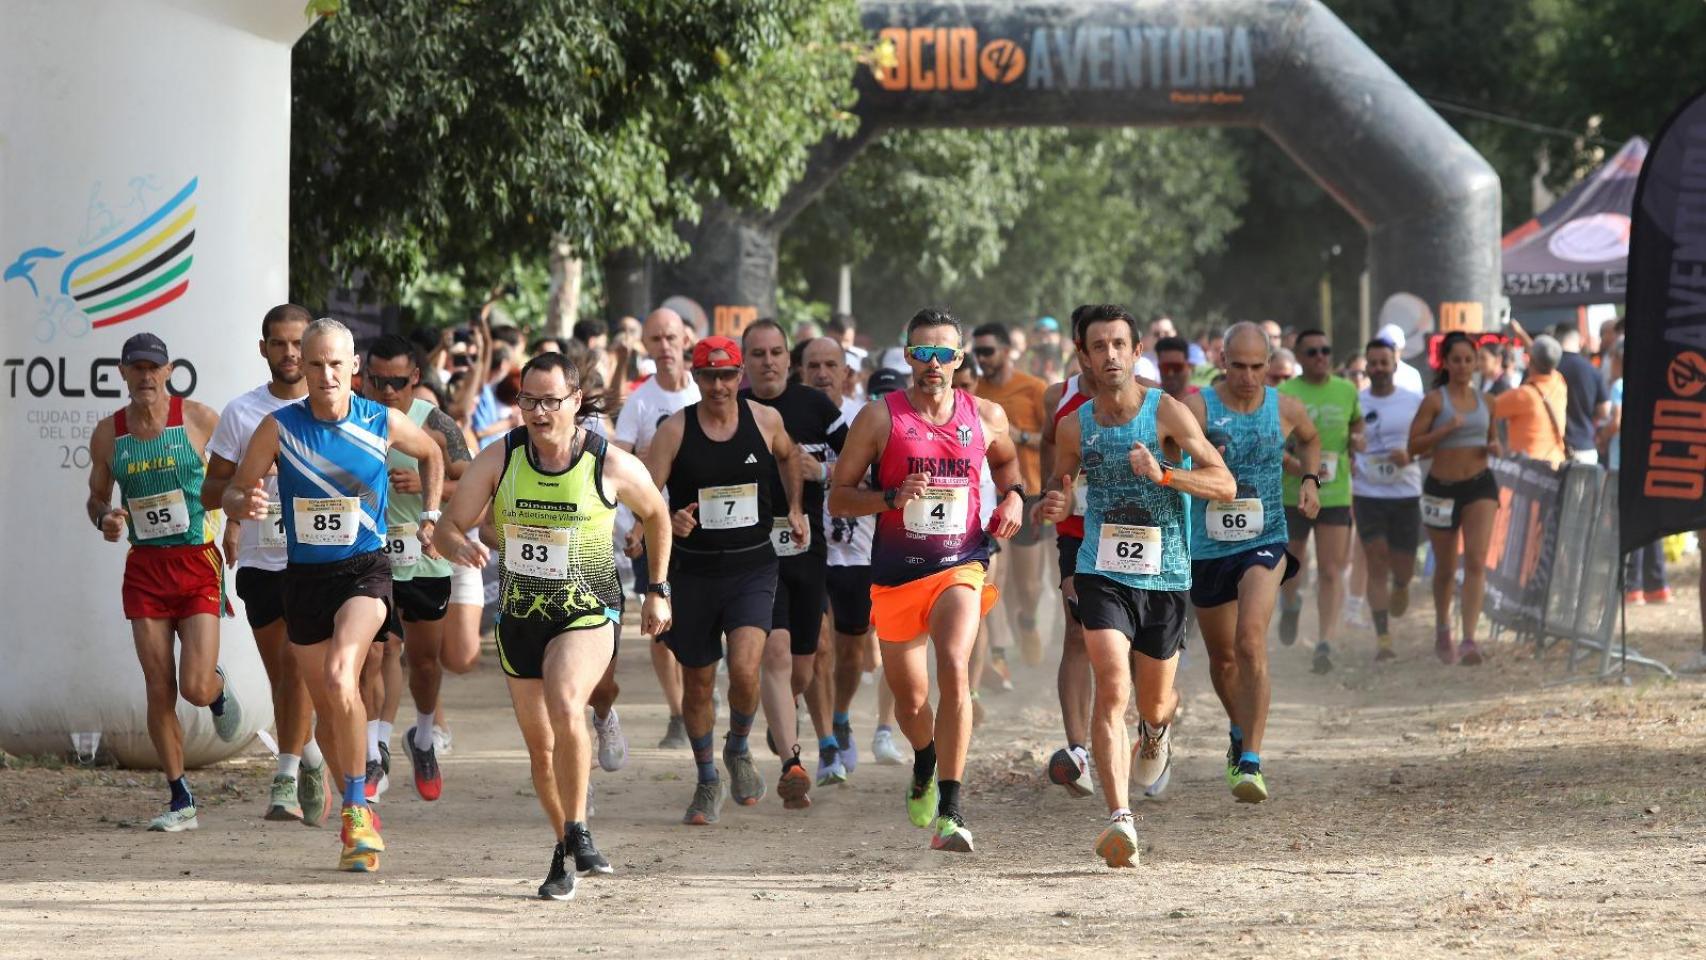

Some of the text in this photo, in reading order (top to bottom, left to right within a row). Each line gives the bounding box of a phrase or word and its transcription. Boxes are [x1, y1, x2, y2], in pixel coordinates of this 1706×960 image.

[878, 26, 1256, 91] OCIO AVENTURA
[3, 356, 197, 399] TOLEO
[27, 410, 80, 424] CIUDAD
[40, 426, 64, 440] DEL
[146, 508, 172, 525] 95
[724, 500, 736, 516] 7
[930, 503, 946, 520] 4
[313, 514, 341, 531] 85
[1222, 514, 1247, 528] 66
[521, 544, 548, 562] 83
[1117, 542, 1144, 559] 62
